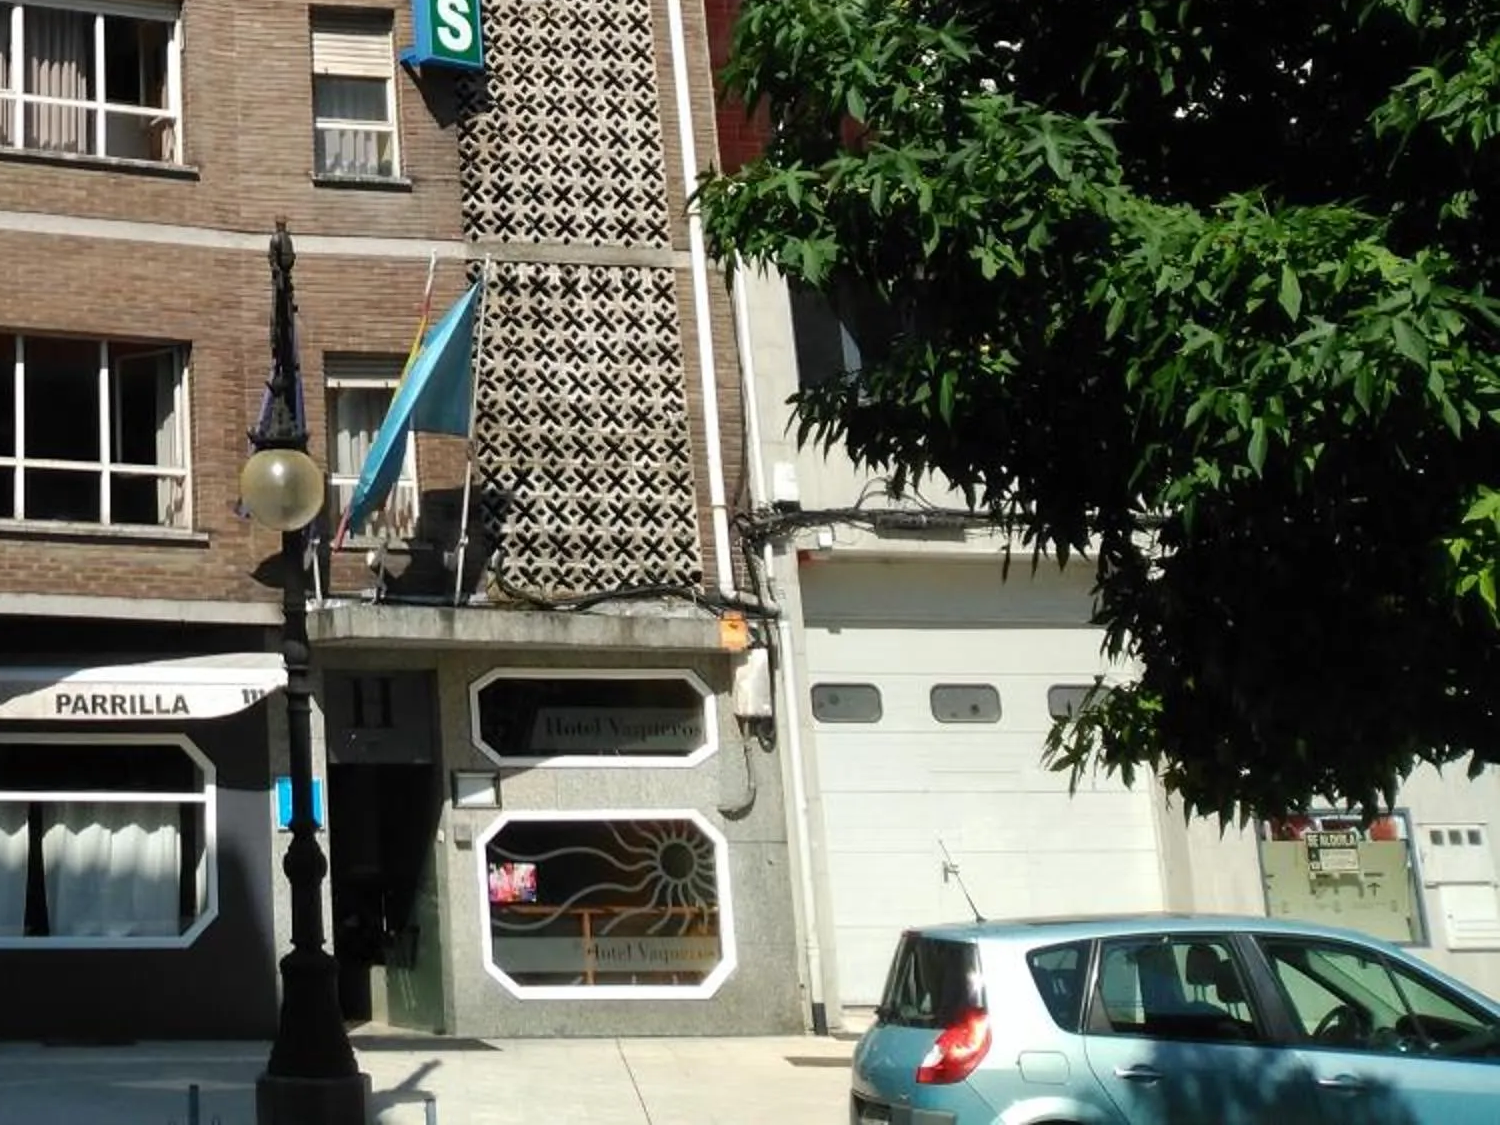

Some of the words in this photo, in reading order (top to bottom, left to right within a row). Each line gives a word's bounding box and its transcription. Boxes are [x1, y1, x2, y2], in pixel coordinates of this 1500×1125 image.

[55, 693, 190, 715] PARRILLA
[546, 716, 601, 736] Hotel
[606, 717, 702, 741] Vaqueros
[587, 942, 632, 961] Hotel
